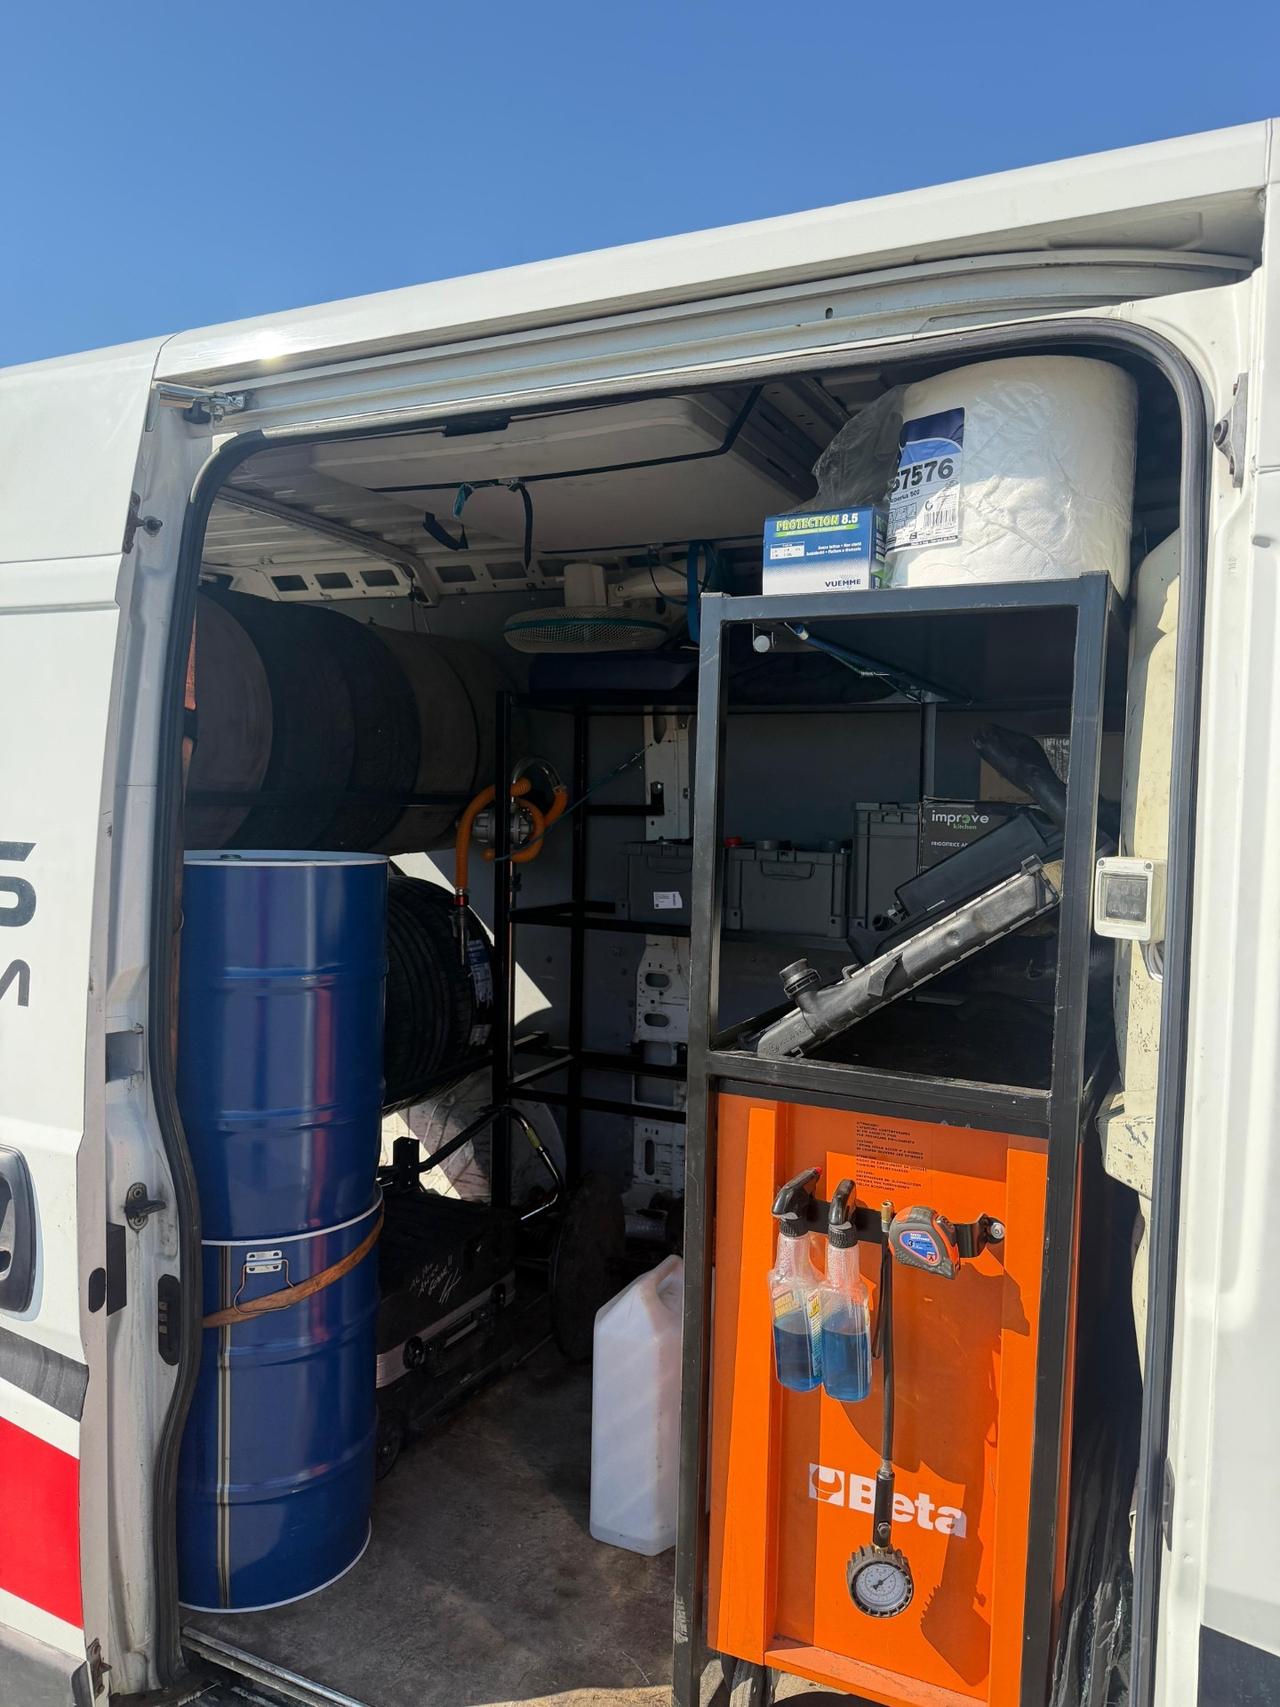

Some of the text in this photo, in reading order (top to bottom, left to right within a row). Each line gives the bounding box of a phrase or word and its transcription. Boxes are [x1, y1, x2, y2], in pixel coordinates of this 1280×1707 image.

[776, 514, 840, 532] PROTECTION
[841, 512, 859, 524] 8.5
[824, 578, 861, 588] VUEMME
[931, 810, 989, 827] improve
[849, 1474, 967, 1539] Beta
